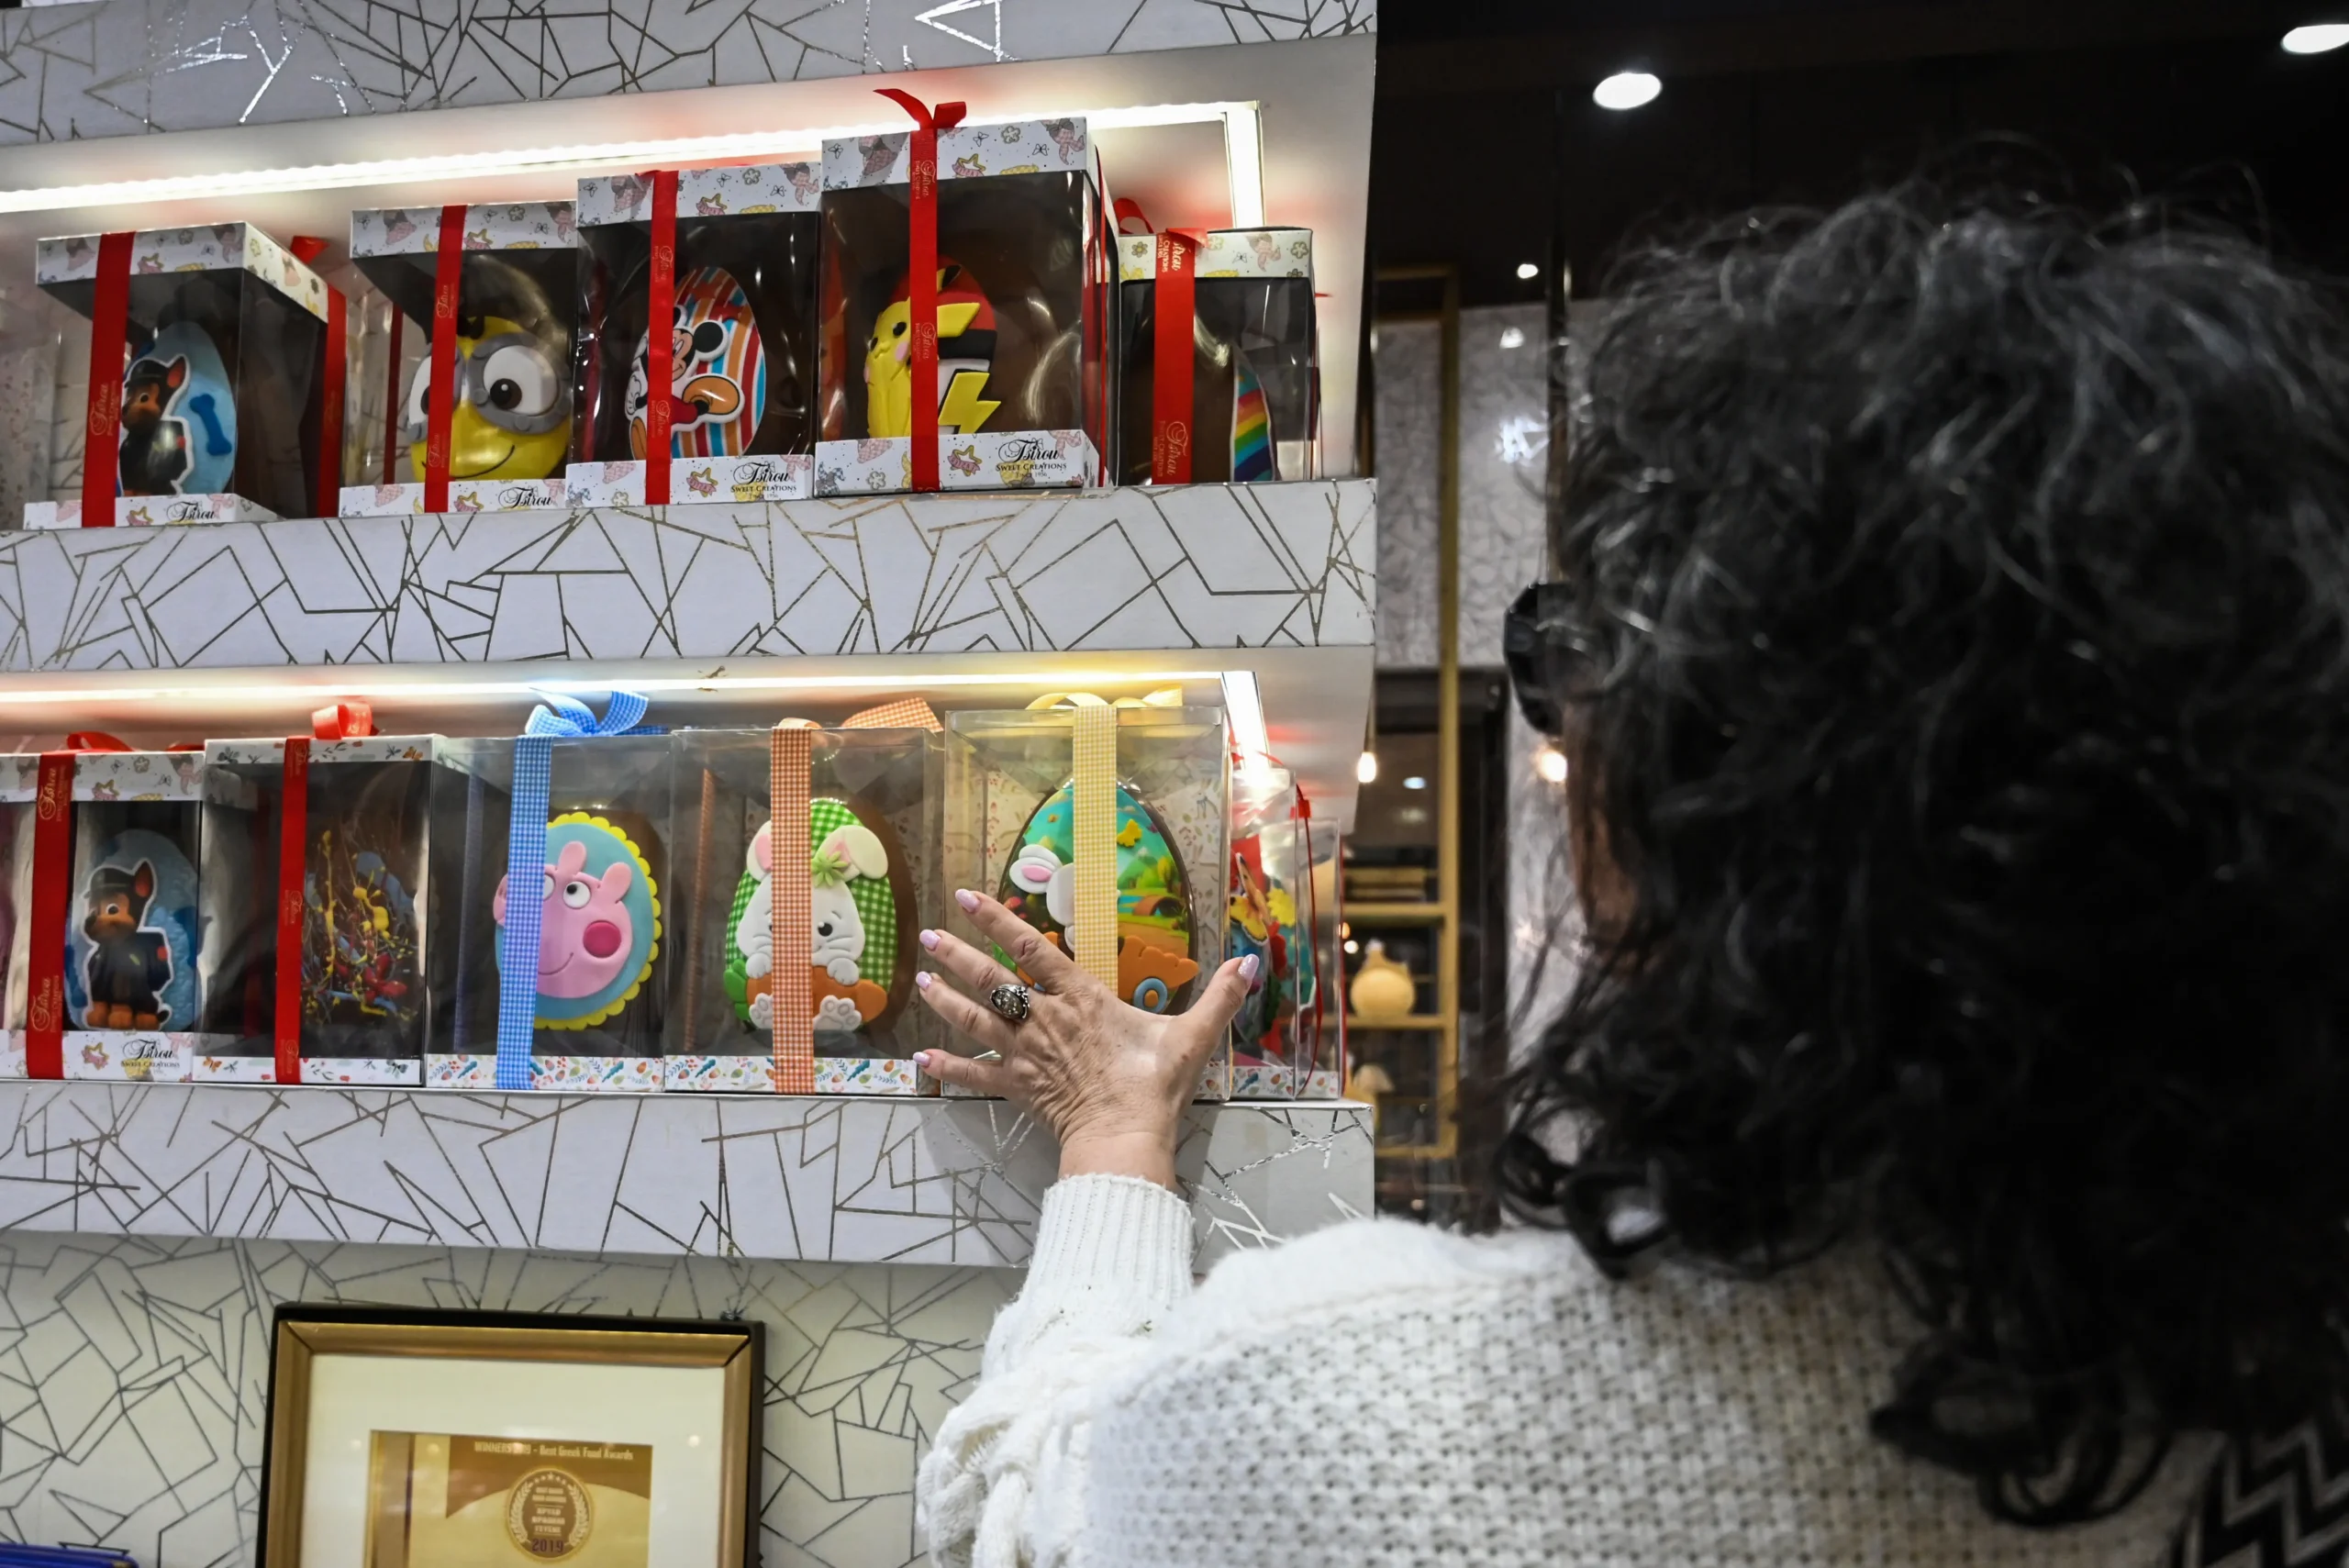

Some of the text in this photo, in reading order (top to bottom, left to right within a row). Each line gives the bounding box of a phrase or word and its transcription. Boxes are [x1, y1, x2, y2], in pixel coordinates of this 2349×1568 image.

[998, 439, 1060, 463] Tsirou
[733, 462, 790, 484] Tsirou
[498, 487, 552, 508] Tsirou
[167, 501, 215, 522] Tsirou
[123, 1039, 174, 1060] Tsirou
[531, 1538, 564, 1553] 2019
